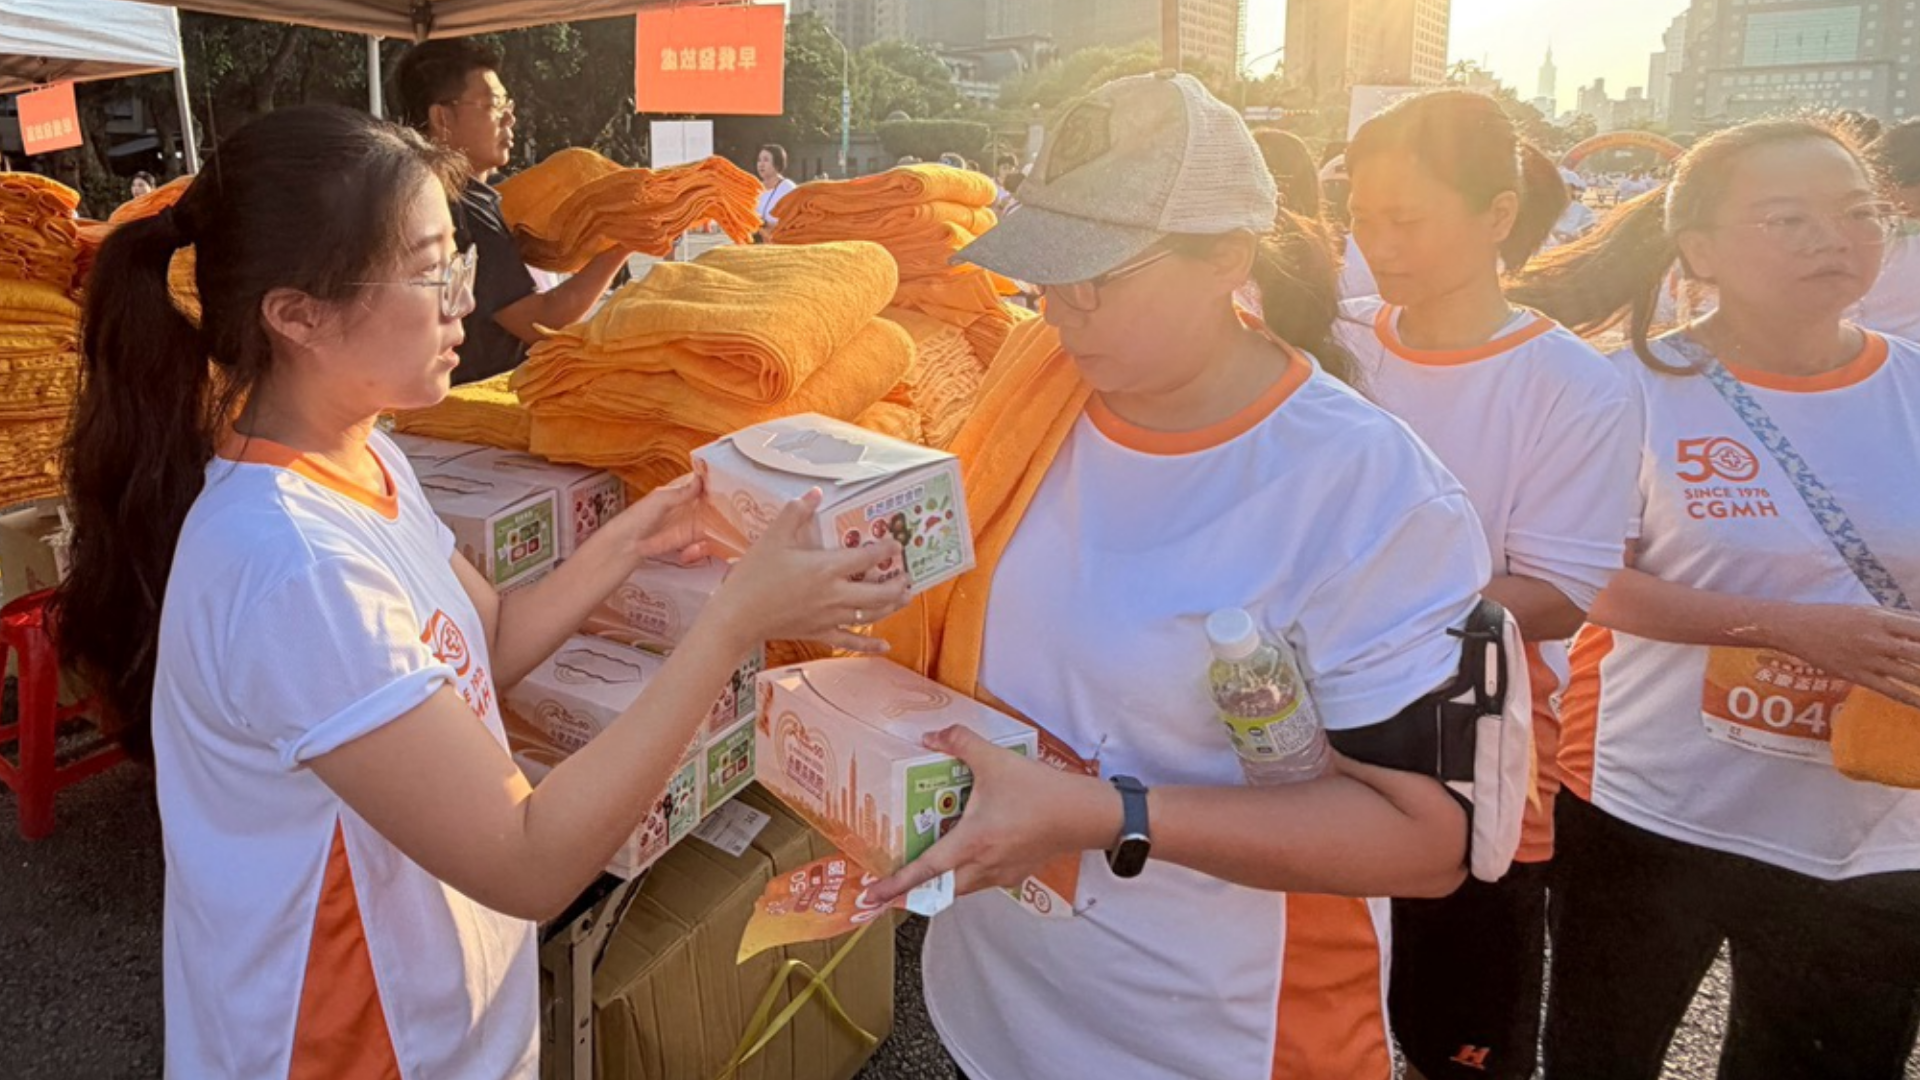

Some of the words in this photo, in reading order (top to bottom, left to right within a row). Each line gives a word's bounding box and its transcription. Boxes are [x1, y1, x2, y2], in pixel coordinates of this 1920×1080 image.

[1675, 436, 1760, 483] 50
[1684, 488, 1733, 499] SINCE
[1738, 487, 1771, 498] 1976
[1687, 501, 1779, 520] CGMH
[1727, 686, 1843, 734] 004
